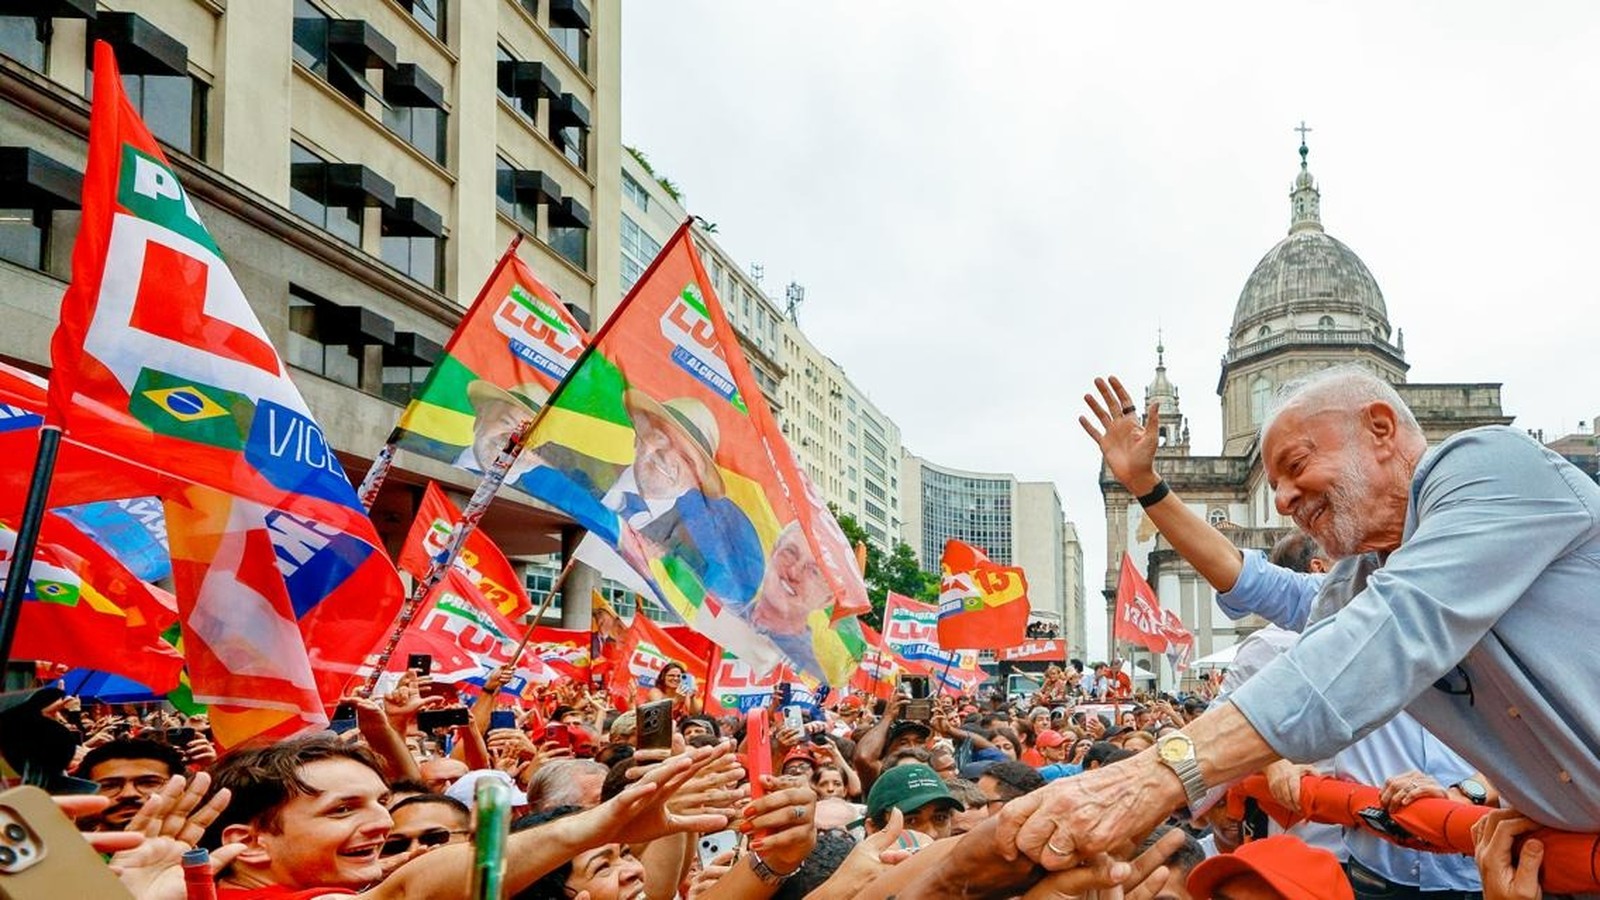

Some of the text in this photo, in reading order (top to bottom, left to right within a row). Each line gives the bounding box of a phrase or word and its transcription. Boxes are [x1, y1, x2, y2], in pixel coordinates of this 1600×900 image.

[686, 357, 735, 395] ALCKMIN
[975, 564, 1010, 595] 13
[1006, 641, 1057, 659] LULA
